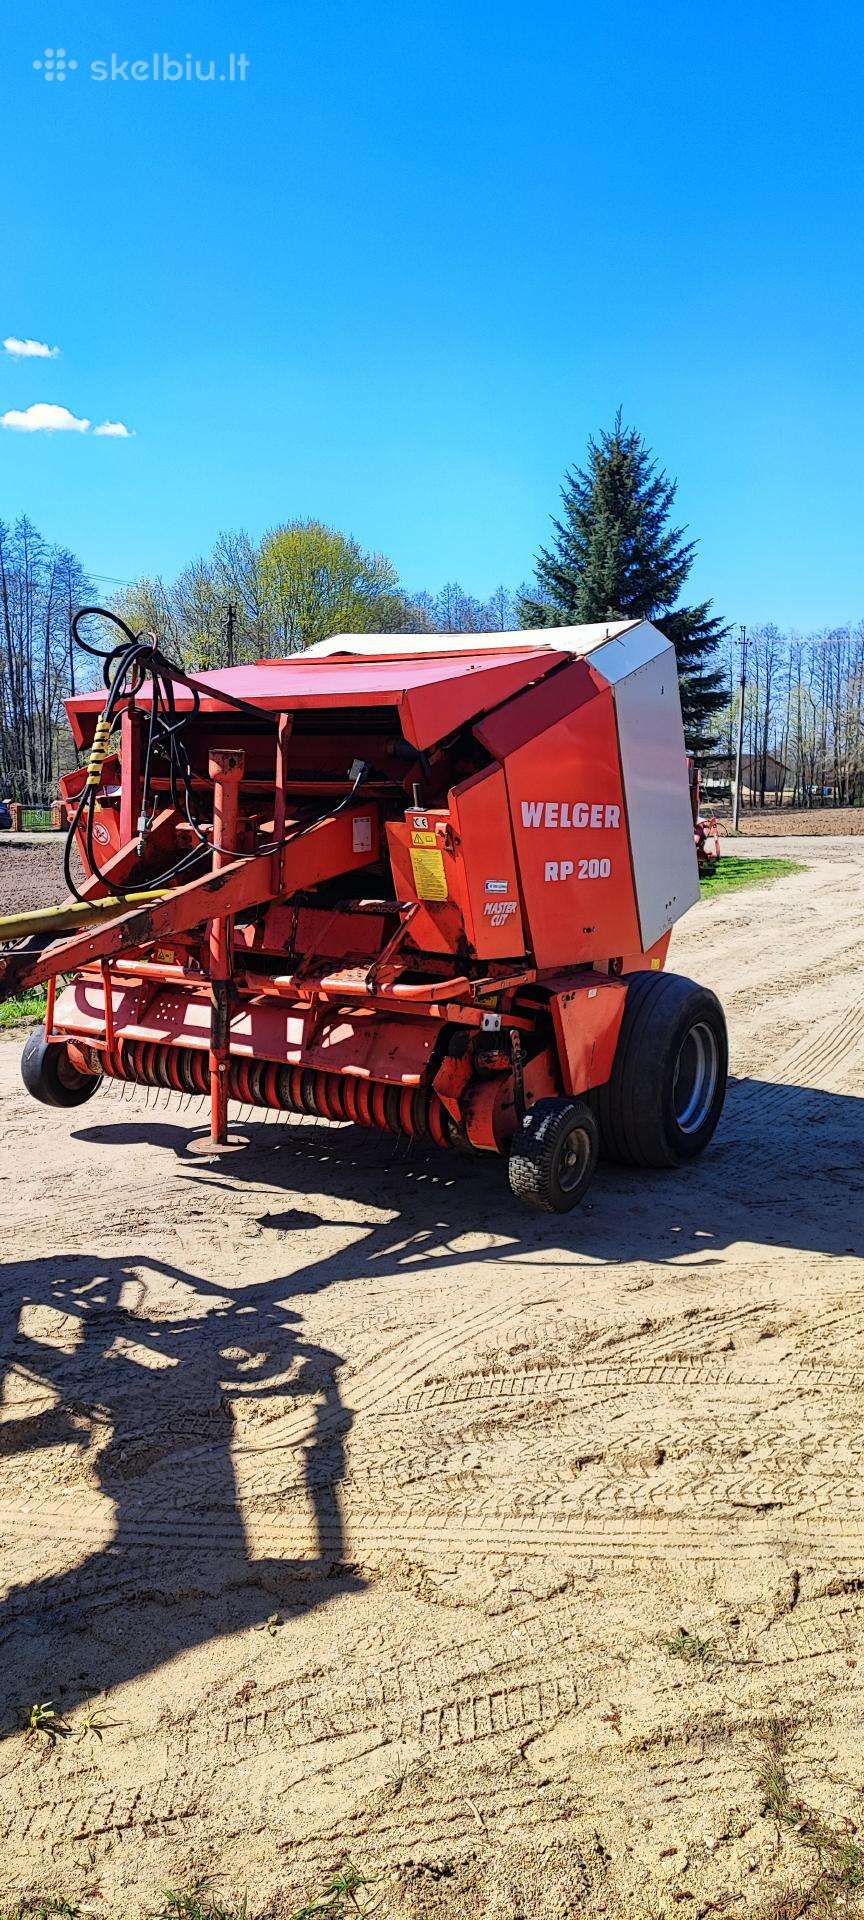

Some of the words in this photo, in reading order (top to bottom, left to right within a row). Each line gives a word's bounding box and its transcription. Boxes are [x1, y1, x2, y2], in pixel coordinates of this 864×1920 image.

[521, 801, 621, 828] WELGER
[544, 861, 574, 882] RP
[578, 858, 611, 880] 200
[484, 902, 517, 915] MASTER
[491, 914, 508, 926] CUT
